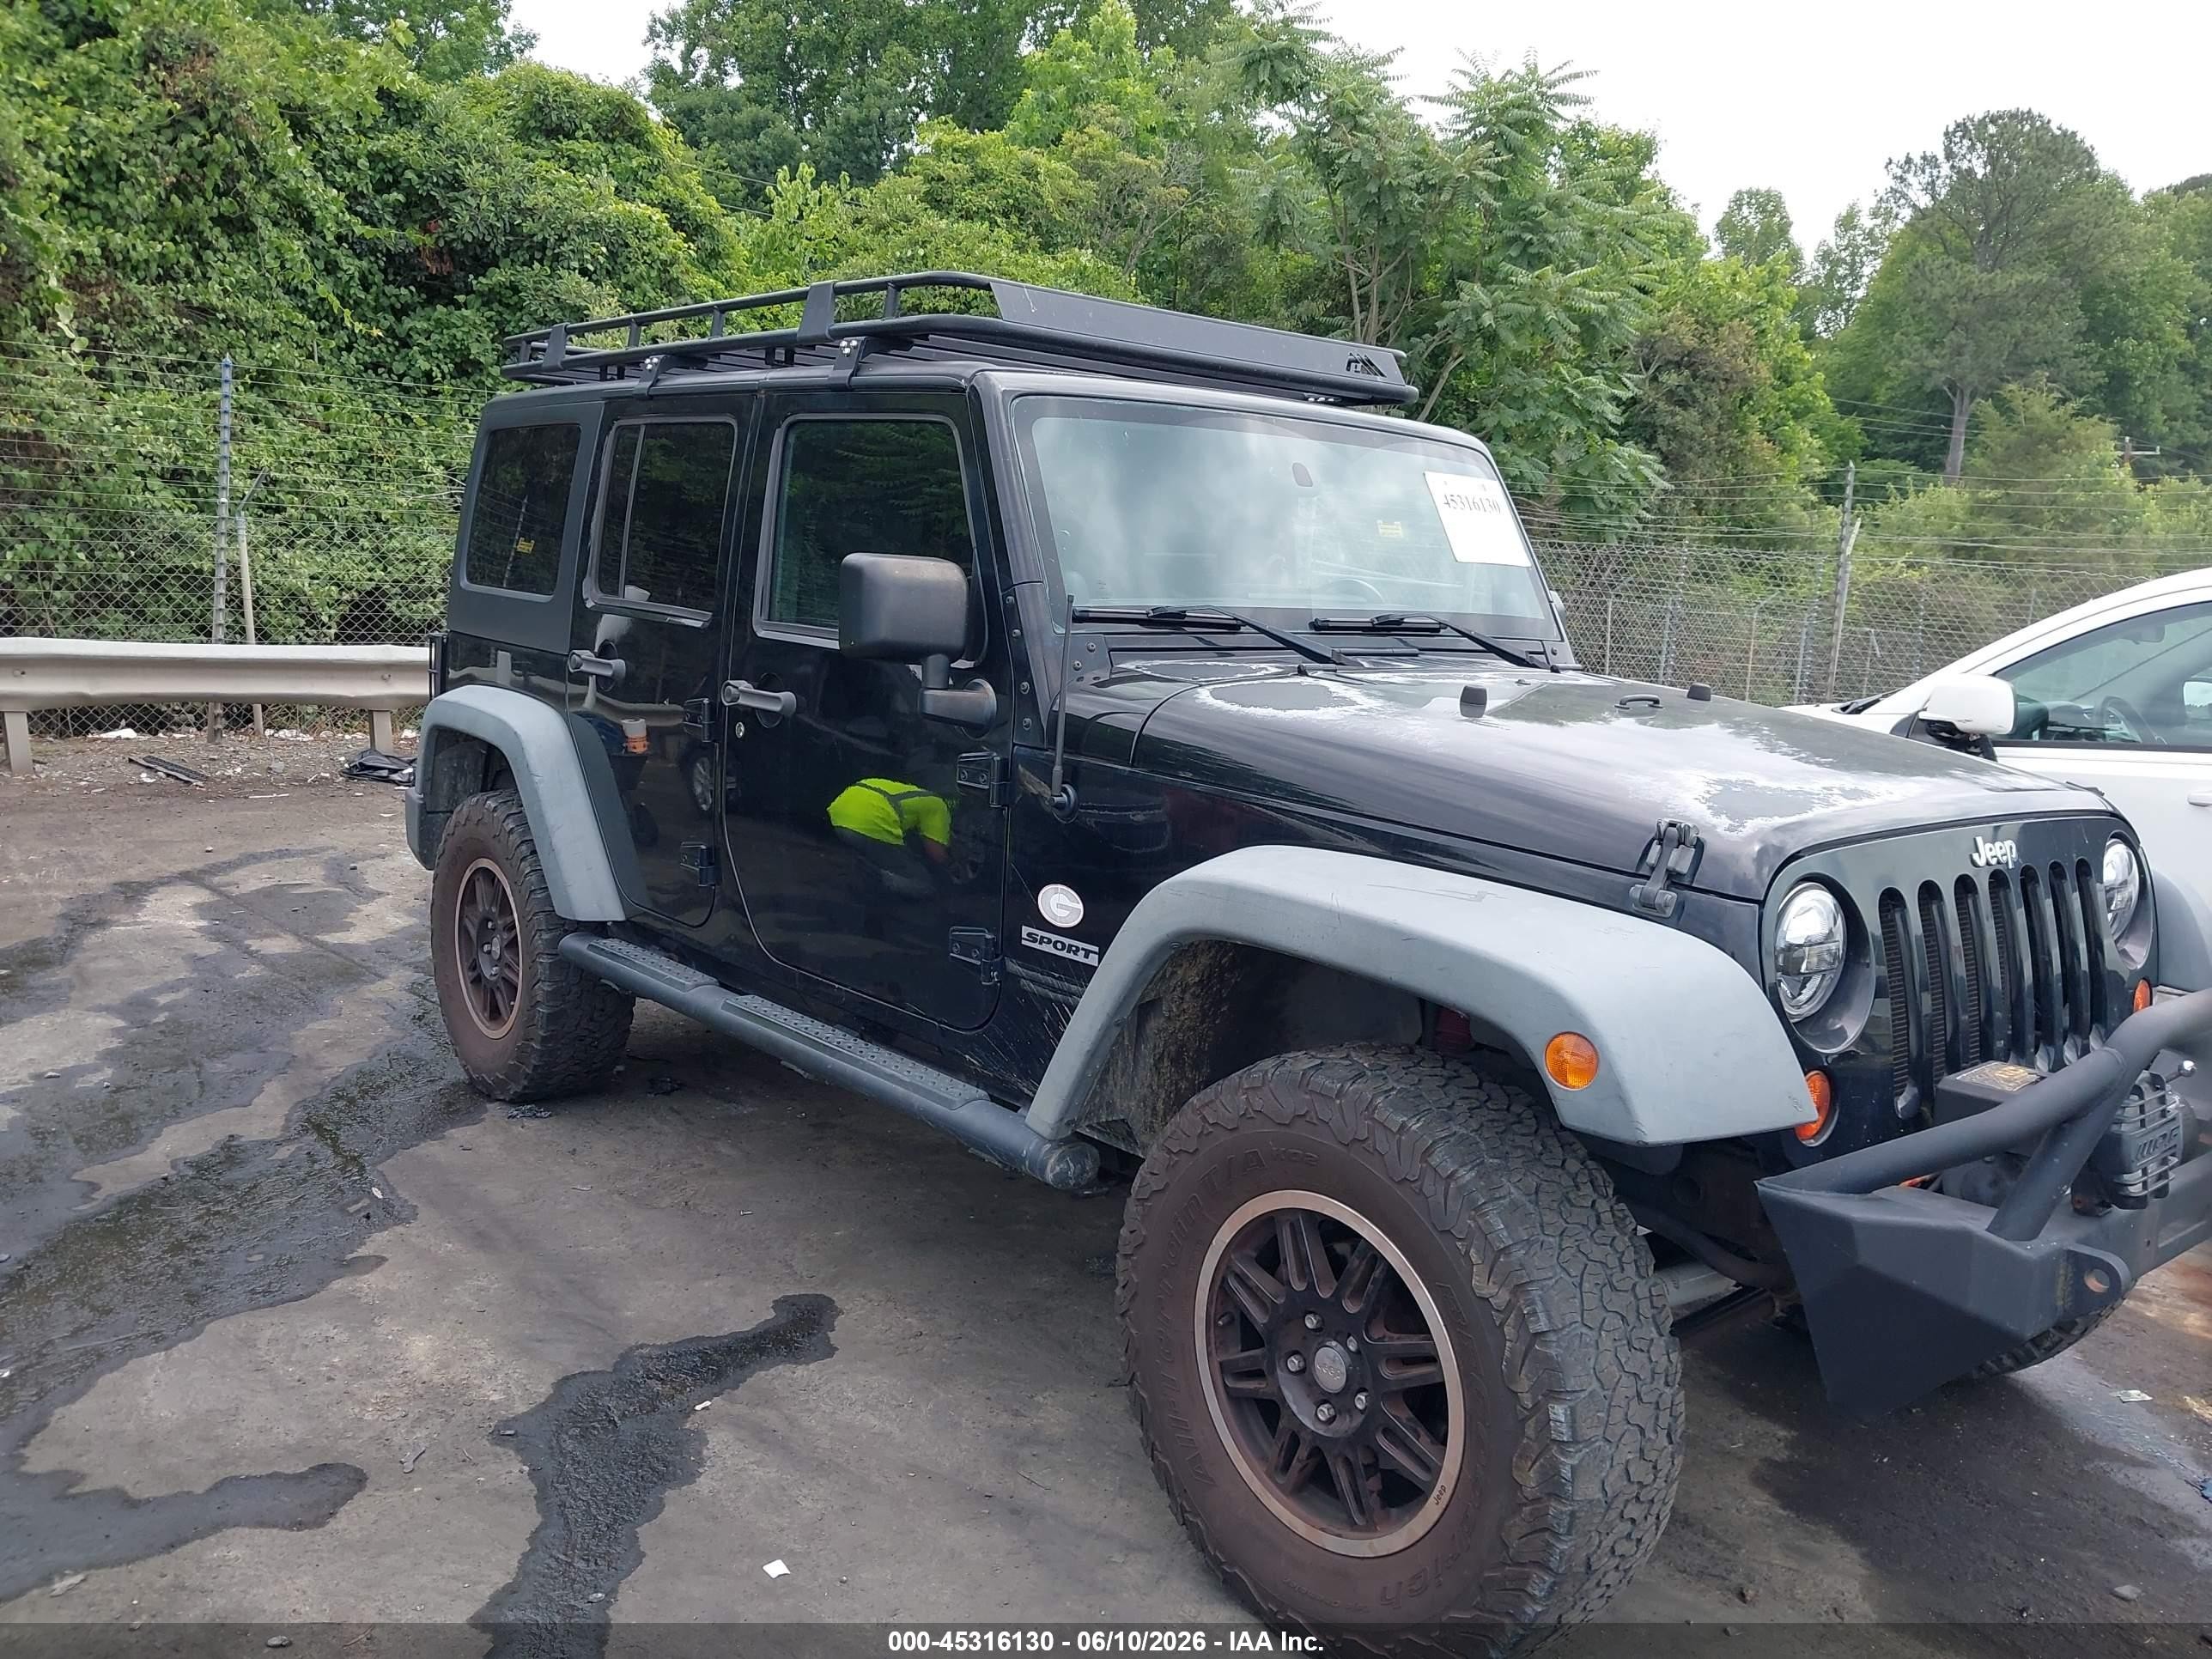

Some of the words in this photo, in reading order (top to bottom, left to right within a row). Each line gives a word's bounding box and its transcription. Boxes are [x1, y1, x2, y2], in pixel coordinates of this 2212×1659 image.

[1970, 836, 2016, 869] Jeep
[1023, 931, 1098, 959] SPORT
[1433, 1484, 1447, 1505] Jeep
